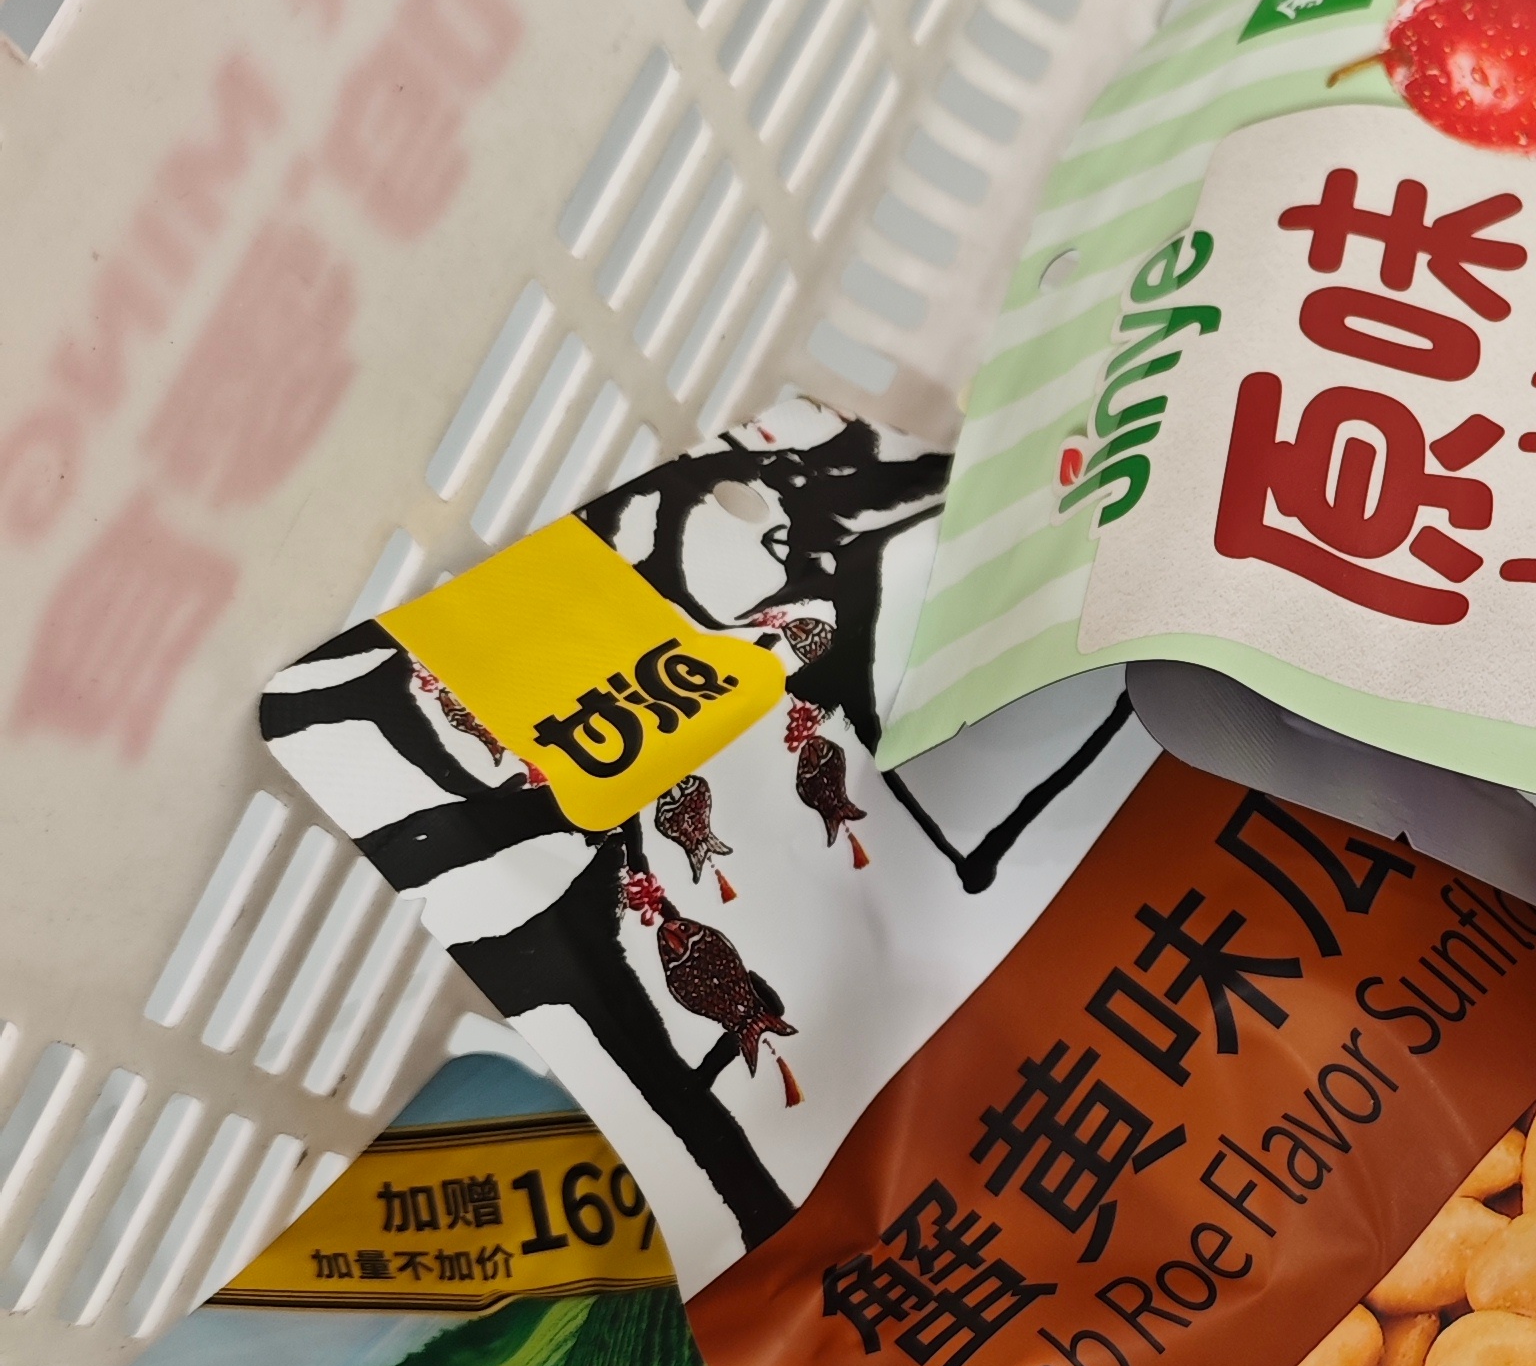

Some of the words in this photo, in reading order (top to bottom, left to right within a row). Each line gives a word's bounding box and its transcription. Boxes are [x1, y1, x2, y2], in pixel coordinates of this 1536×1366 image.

[1214, 168, 1527, 625] 原味
[311, 1247, 514, 1283] 加量不加价
[378, 1173, 505, 1235] 加赠
[1096, 1218, 1256, 1356] Roe
[1200, 1028, 1400, 1239] Flavor
